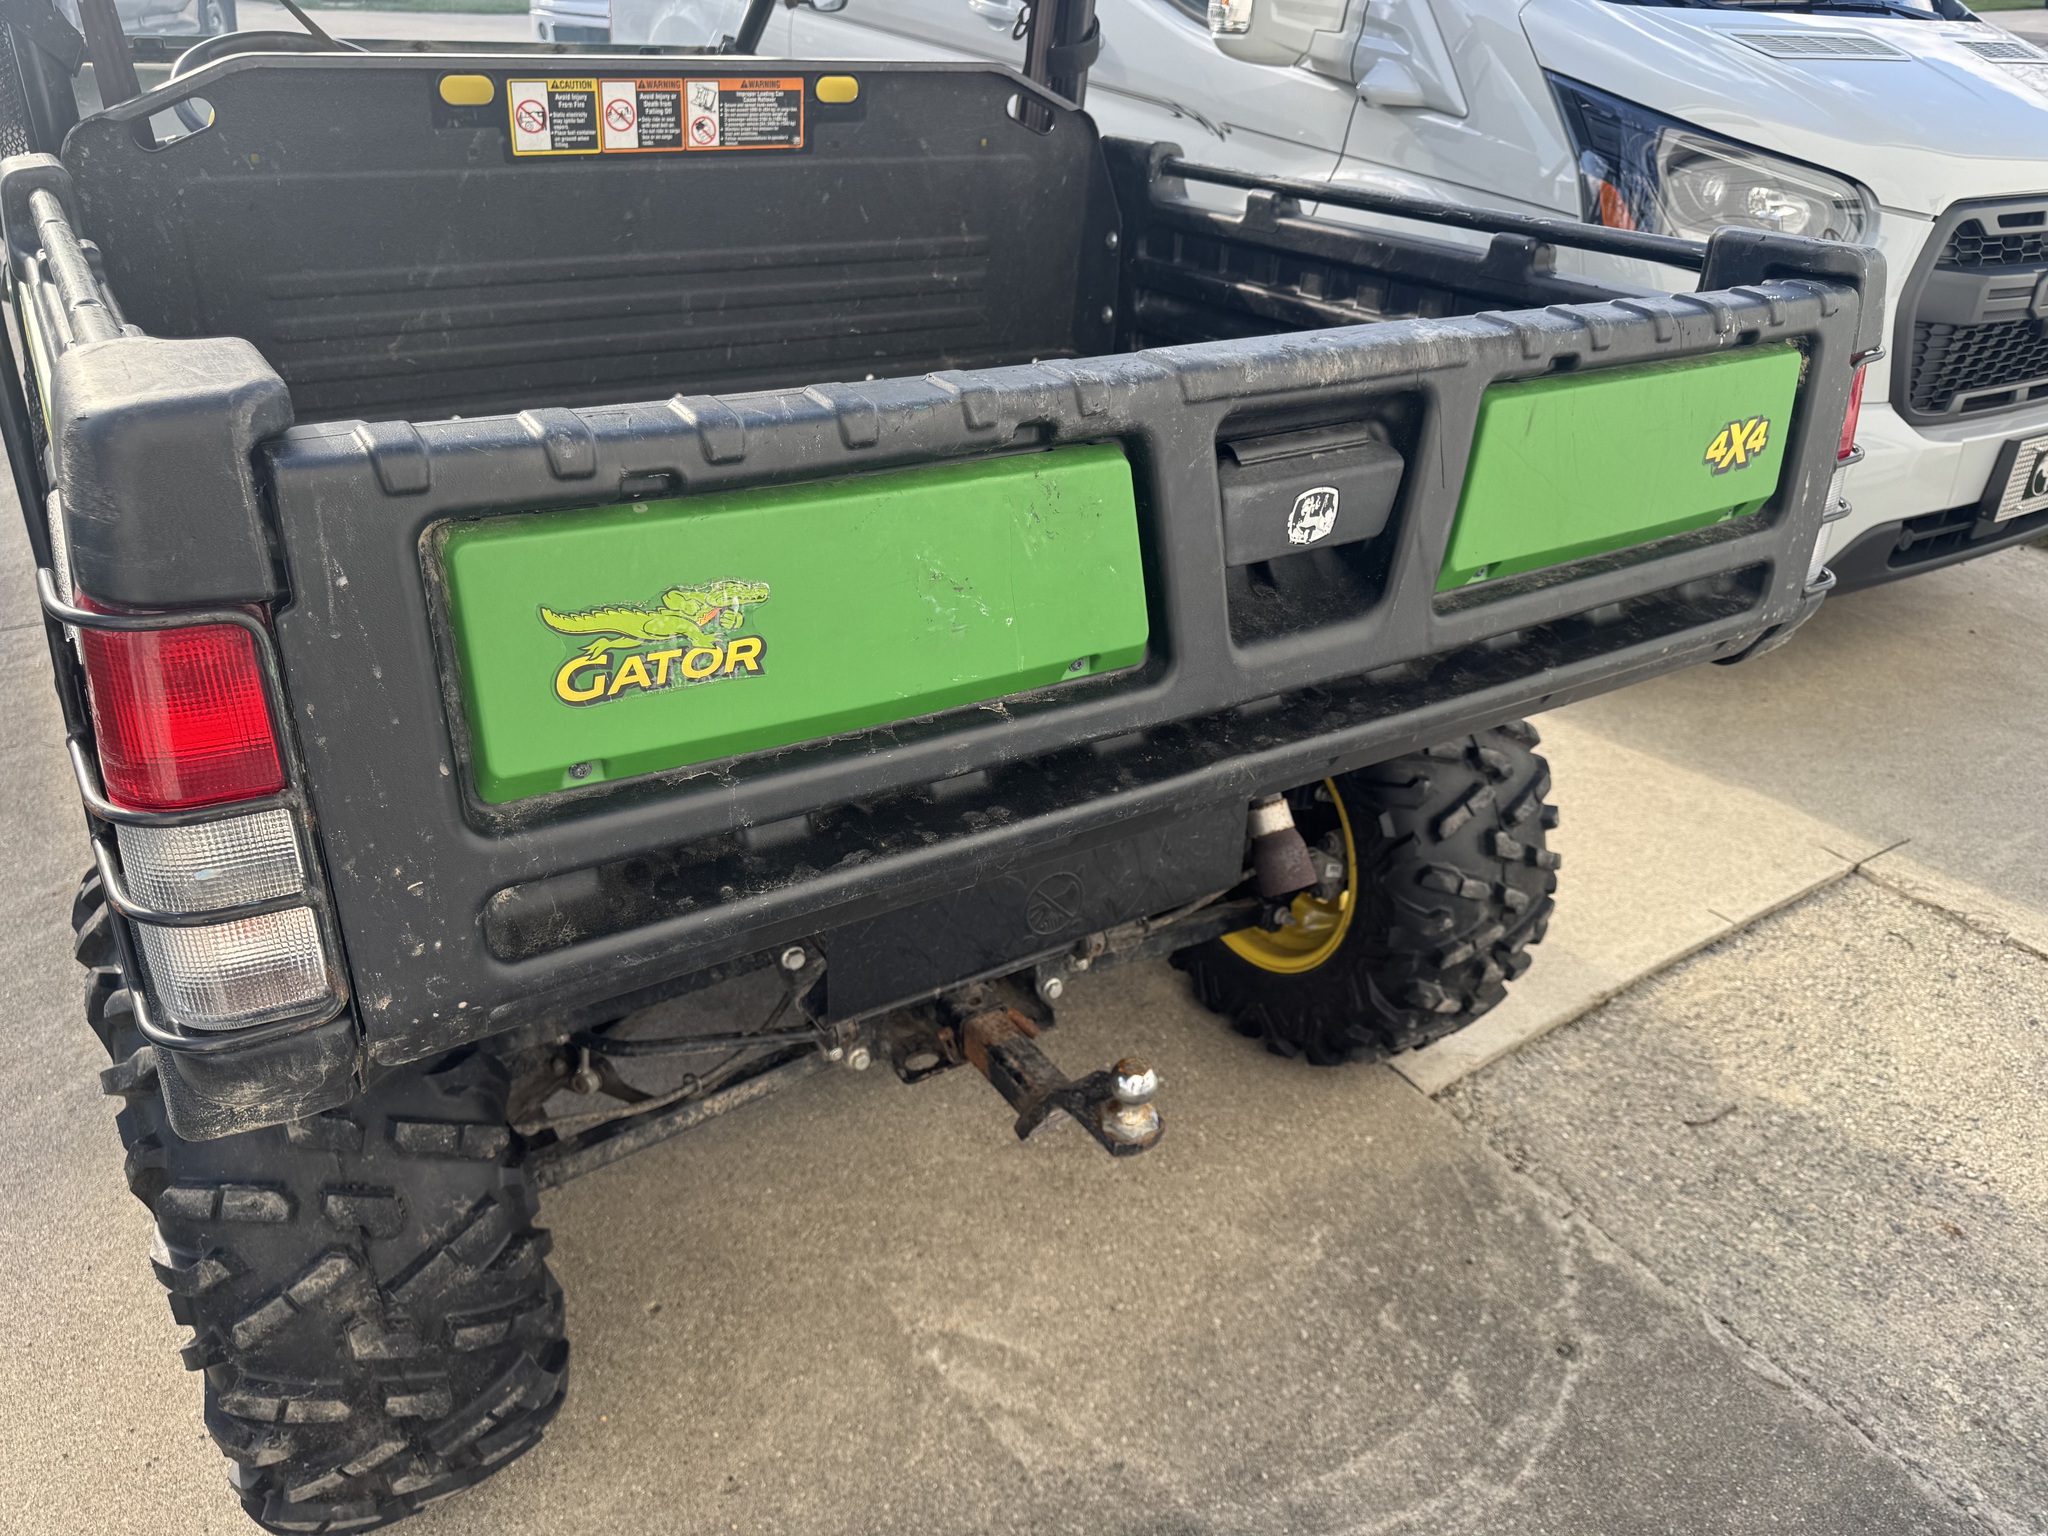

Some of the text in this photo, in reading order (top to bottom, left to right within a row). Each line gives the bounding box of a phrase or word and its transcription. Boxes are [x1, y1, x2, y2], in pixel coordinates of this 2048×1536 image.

[648, 80, 680, 88] WARNING
[748, 80, 780, 88] WARNING
[1704, 417, 1769, 471] 4X4
[555, 636, 764, 705] GATOR
